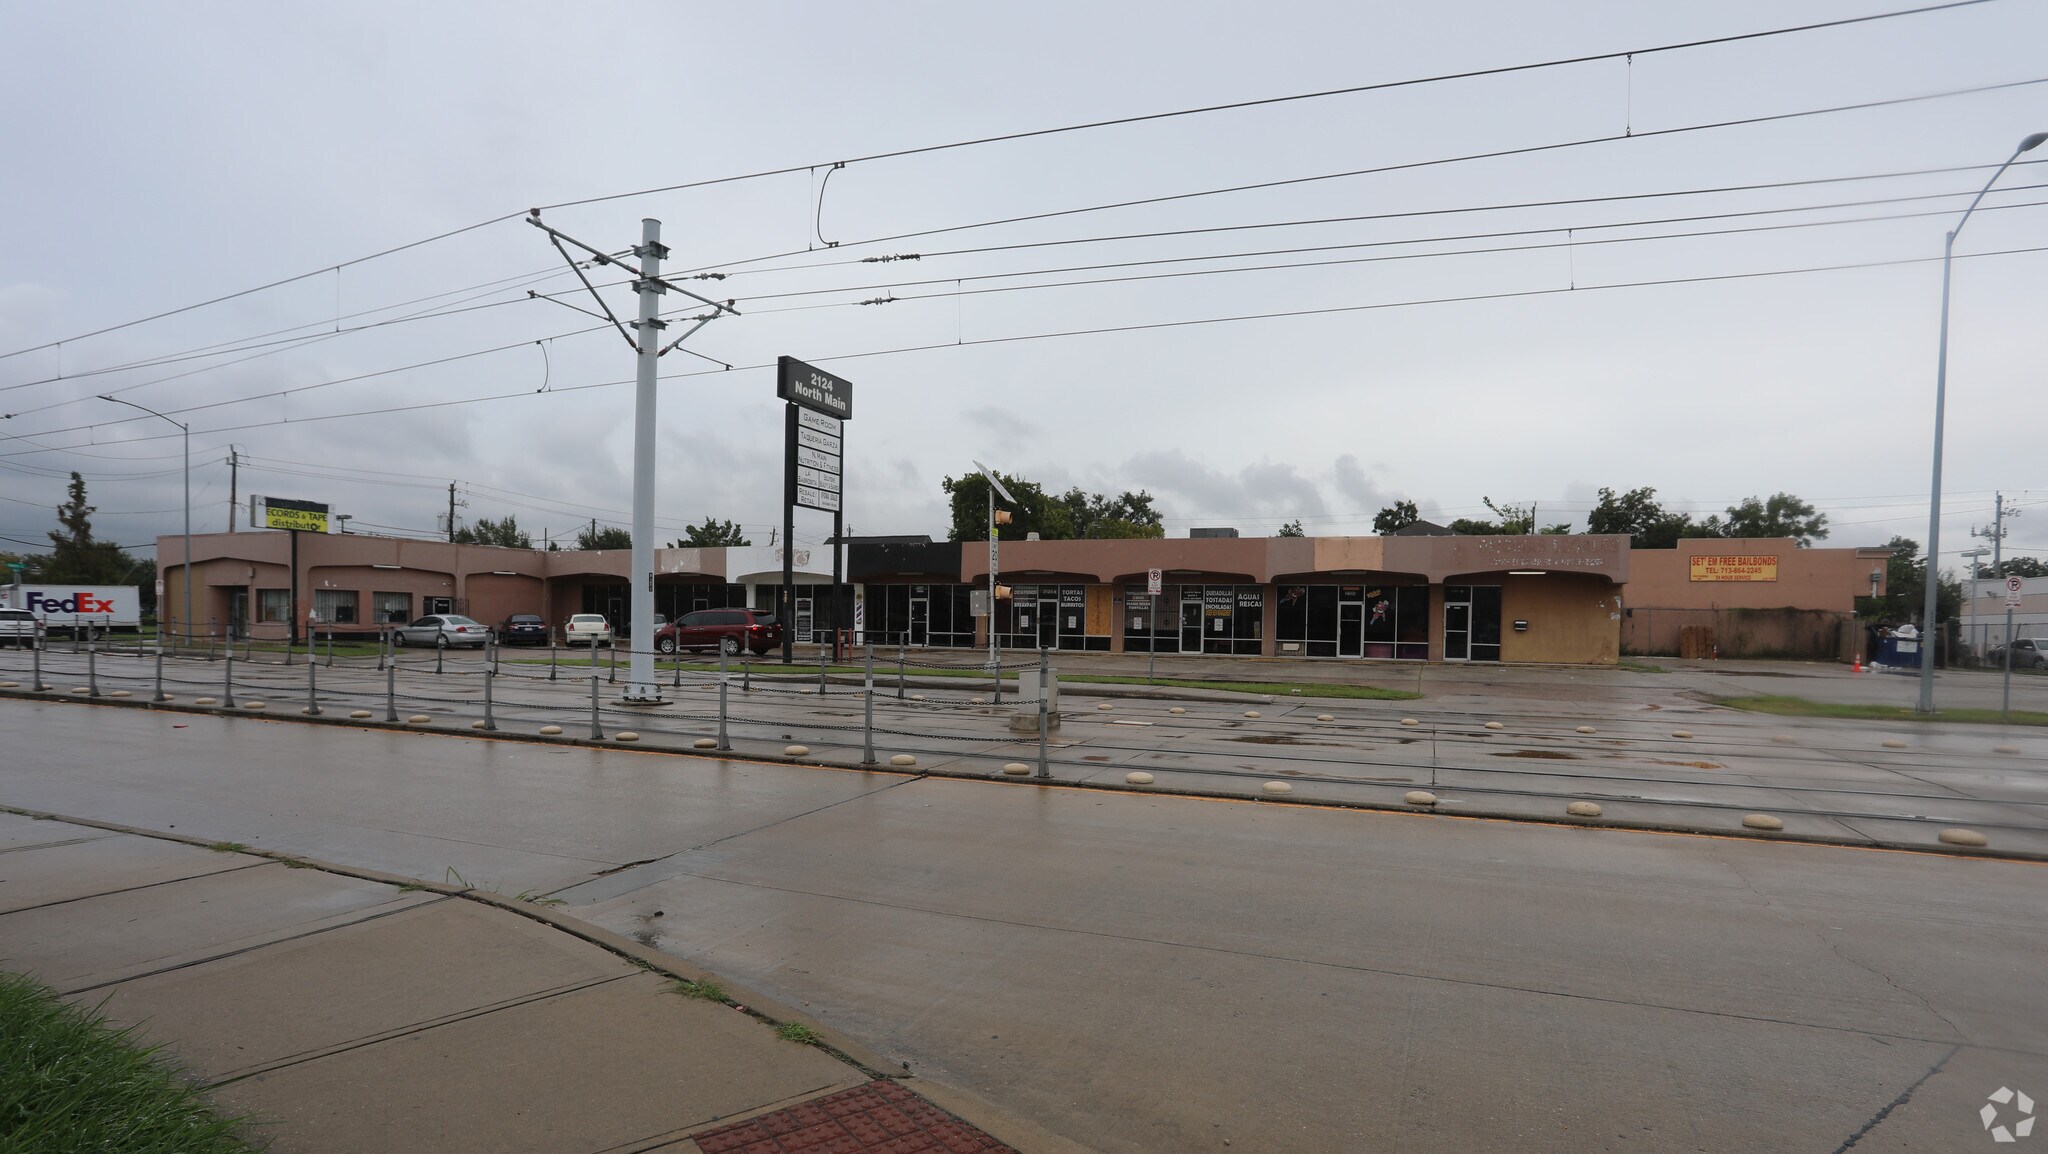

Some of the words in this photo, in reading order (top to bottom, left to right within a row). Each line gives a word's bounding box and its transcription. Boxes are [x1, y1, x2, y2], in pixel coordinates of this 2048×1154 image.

[811, 373, 834, 391] 2124
[795, 380, 822, 402] North
[824, 392, 846, 411] Main
[803, 413, 820, 425] GAME
[820, 418, 837, 431] ROOM
[800, 431, 822, 444] TAQUERIA
[822, 438, 838, 448] GARZA
[1708, 557, 1718, 566] EM
[1719, 557, 1736, 566] FREE
[1738, 557, 1776, 566] BAILBONDS
[27, 592, 114, 613] FedEx
